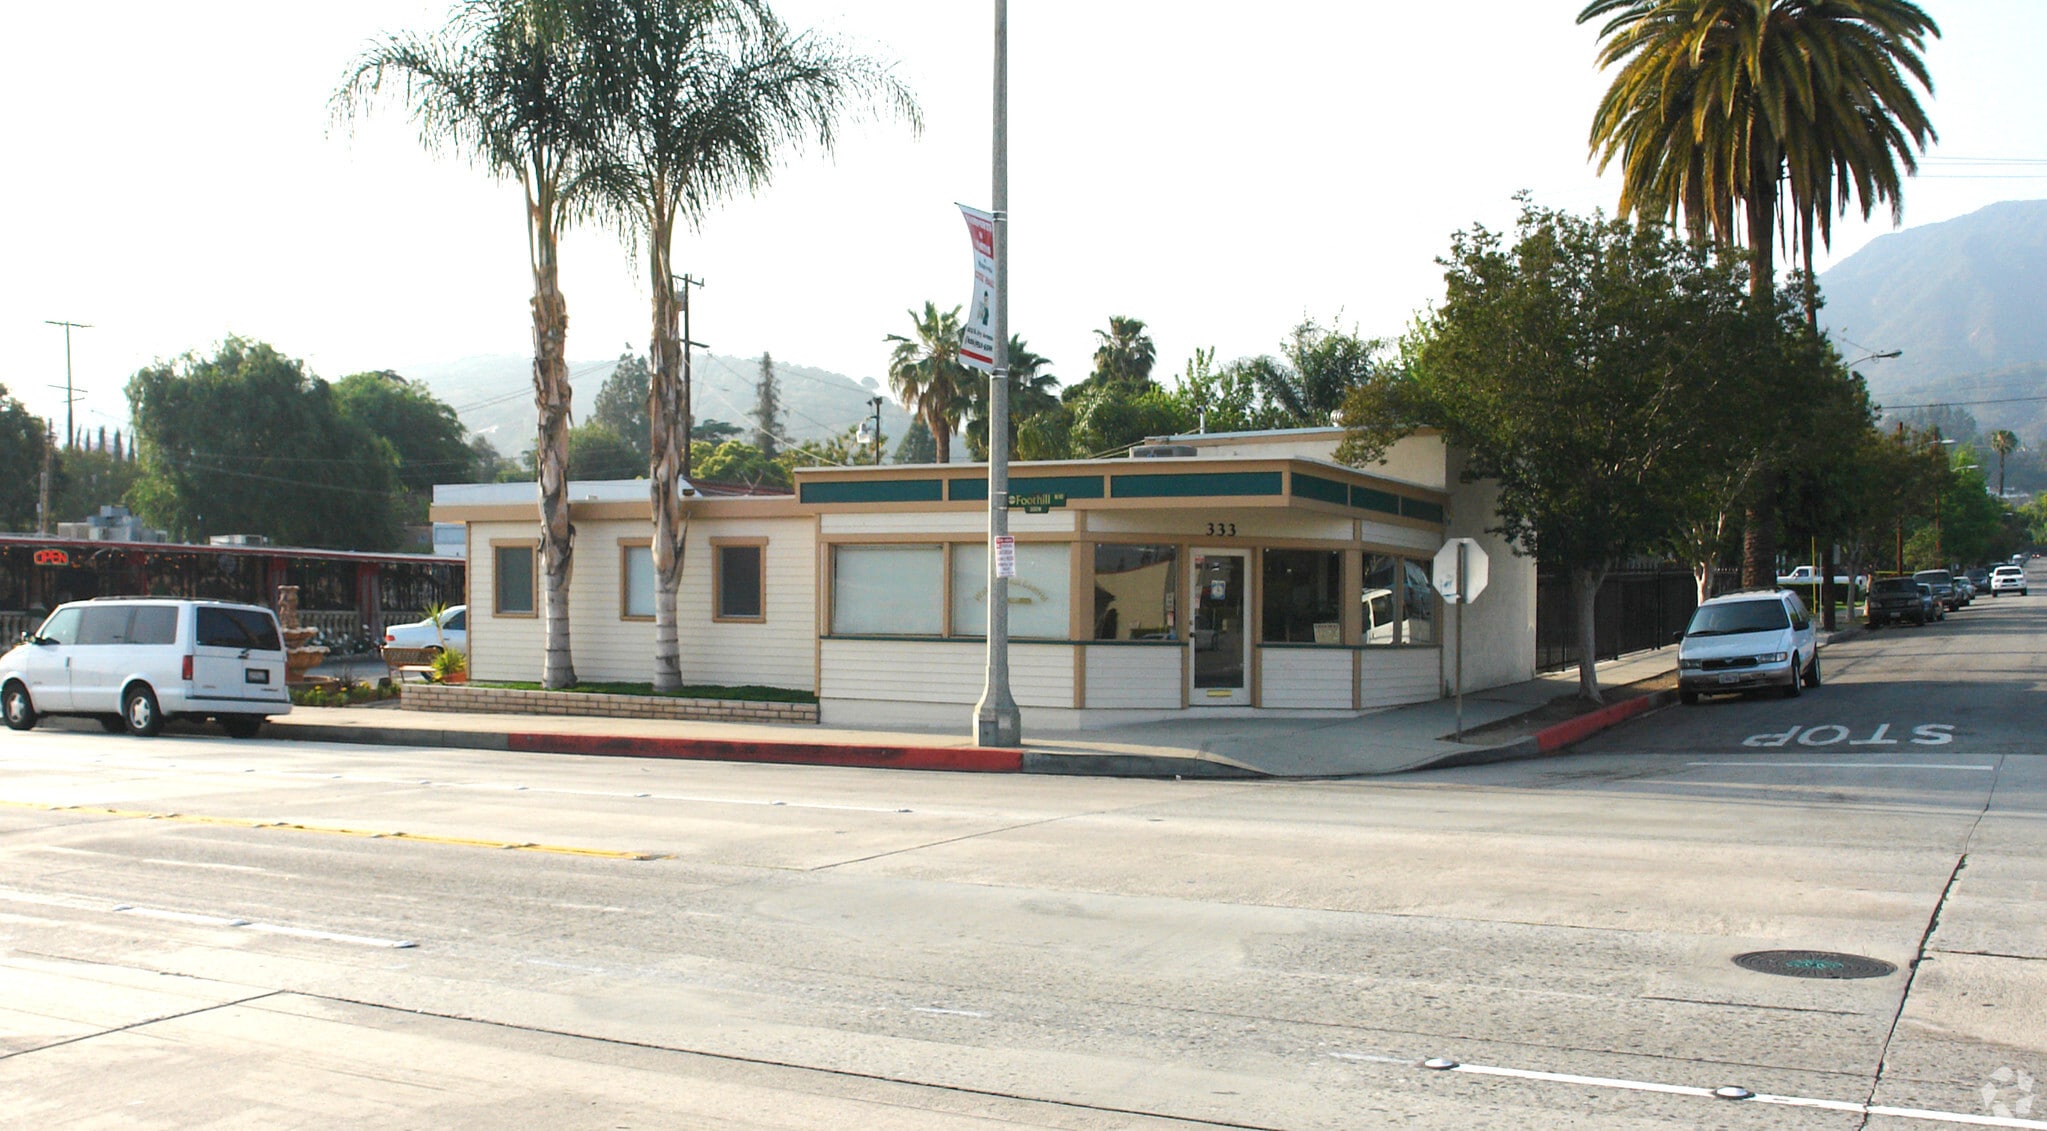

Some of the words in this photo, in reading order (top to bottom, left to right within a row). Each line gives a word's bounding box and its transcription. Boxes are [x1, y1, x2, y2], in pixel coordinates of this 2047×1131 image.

[1016, 494, 1051, 505] Foothill
[1206, 522, 1236, 537] 333
[34, 549, 69, 566] OPEN
[1741, 723, 1956, 747] STOP
